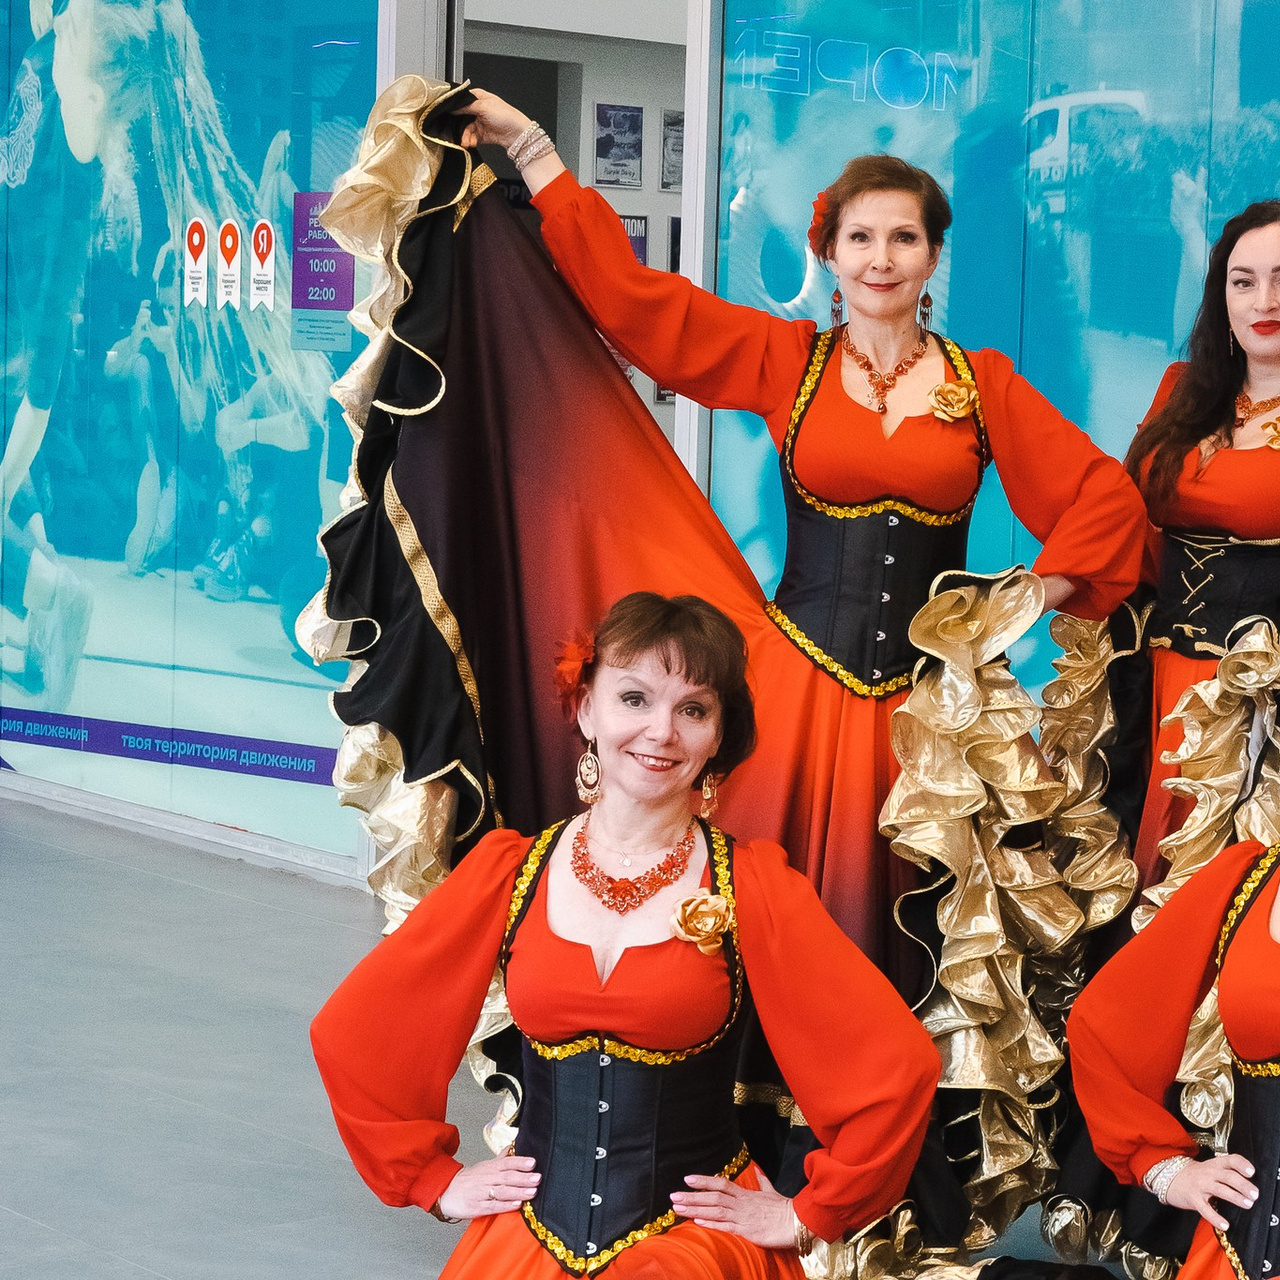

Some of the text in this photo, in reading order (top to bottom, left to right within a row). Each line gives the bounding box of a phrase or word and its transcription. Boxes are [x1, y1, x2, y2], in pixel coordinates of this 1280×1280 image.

[620, 218, 645, 237] ПОМ
[309, 259, 336, 273] 10:00
[308, 287, 336, 300] 22:00
[25, 722, 89, 742] движения
[121, 734, 316, 772] твоя территория движения
